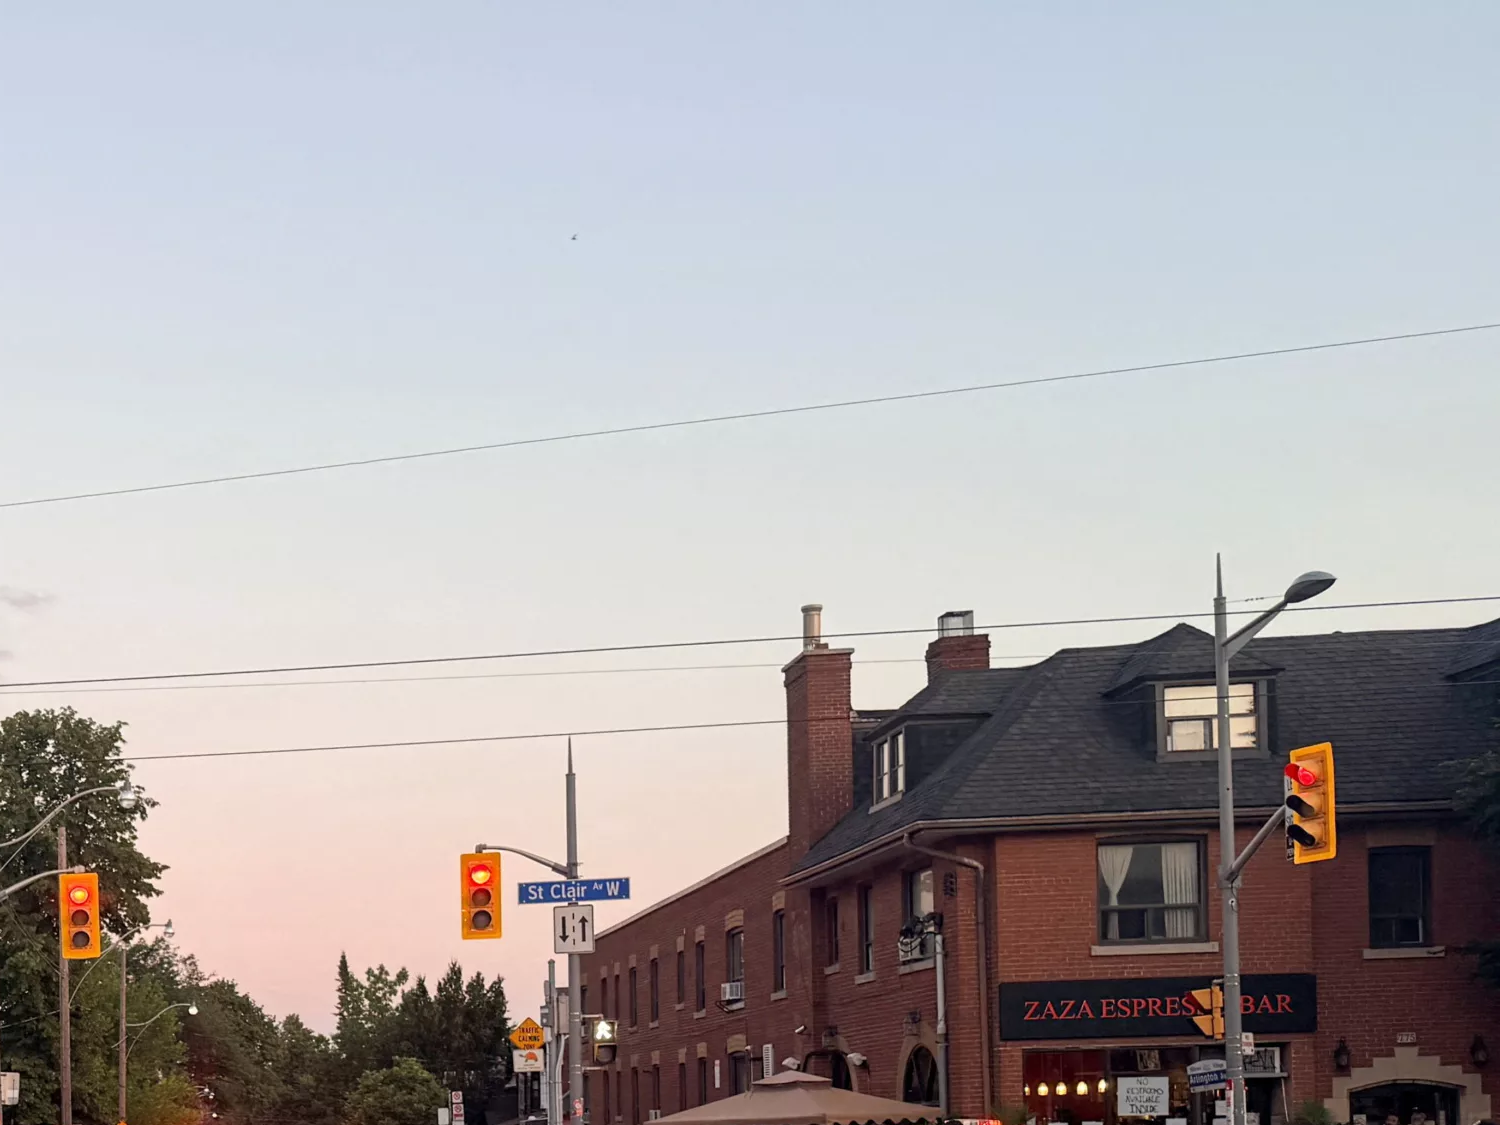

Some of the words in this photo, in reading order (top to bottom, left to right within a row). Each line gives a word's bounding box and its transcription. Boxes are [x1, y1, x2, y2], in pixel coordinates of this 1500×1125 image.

[528, 885, 544, 900] St
[550, 884, 587, 898] Clair
[607, 881, 620, 896] W
[1024, 999, 1095, 1020] ZAZA
[1100, 997, 1198, 1019] ESPRES
[1240, 994, 1294, 1014] BAR
